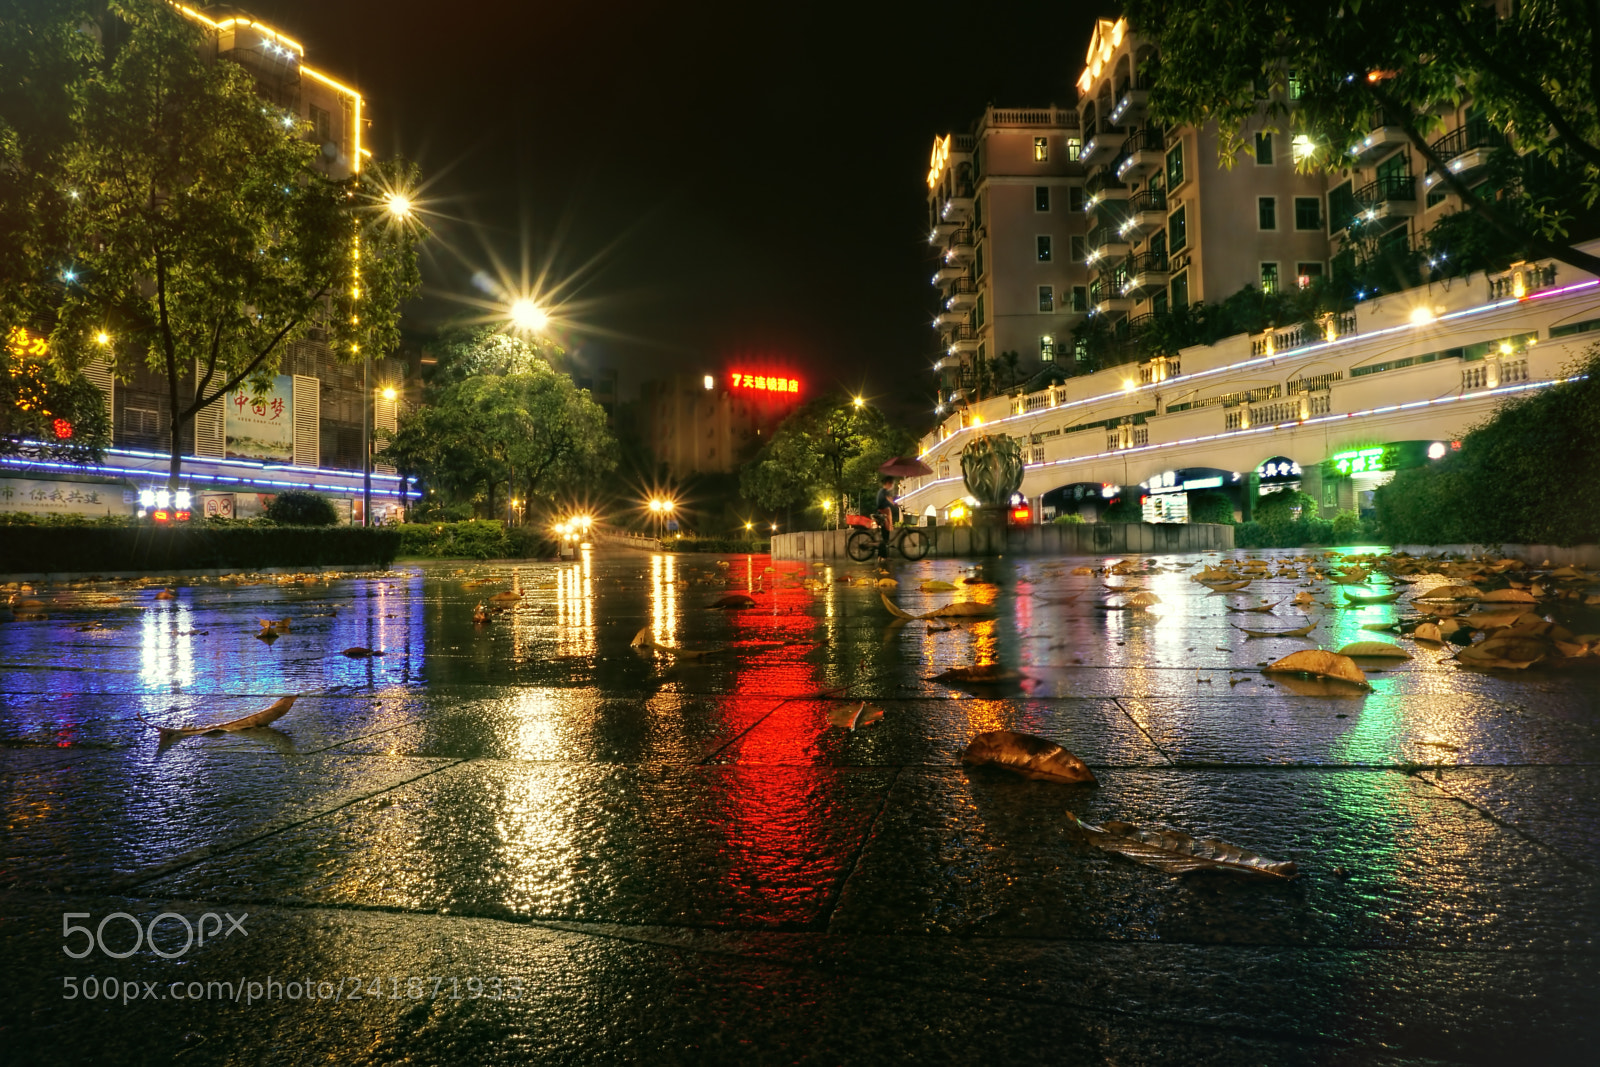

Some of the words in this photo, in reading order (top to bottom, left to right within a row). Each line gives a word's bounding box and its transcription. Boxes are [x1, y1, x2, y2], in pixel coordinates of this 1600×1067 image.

[732, 373, 799, 393] 7天连锁酒店
[233, 390, 286, 421] 中国梦
